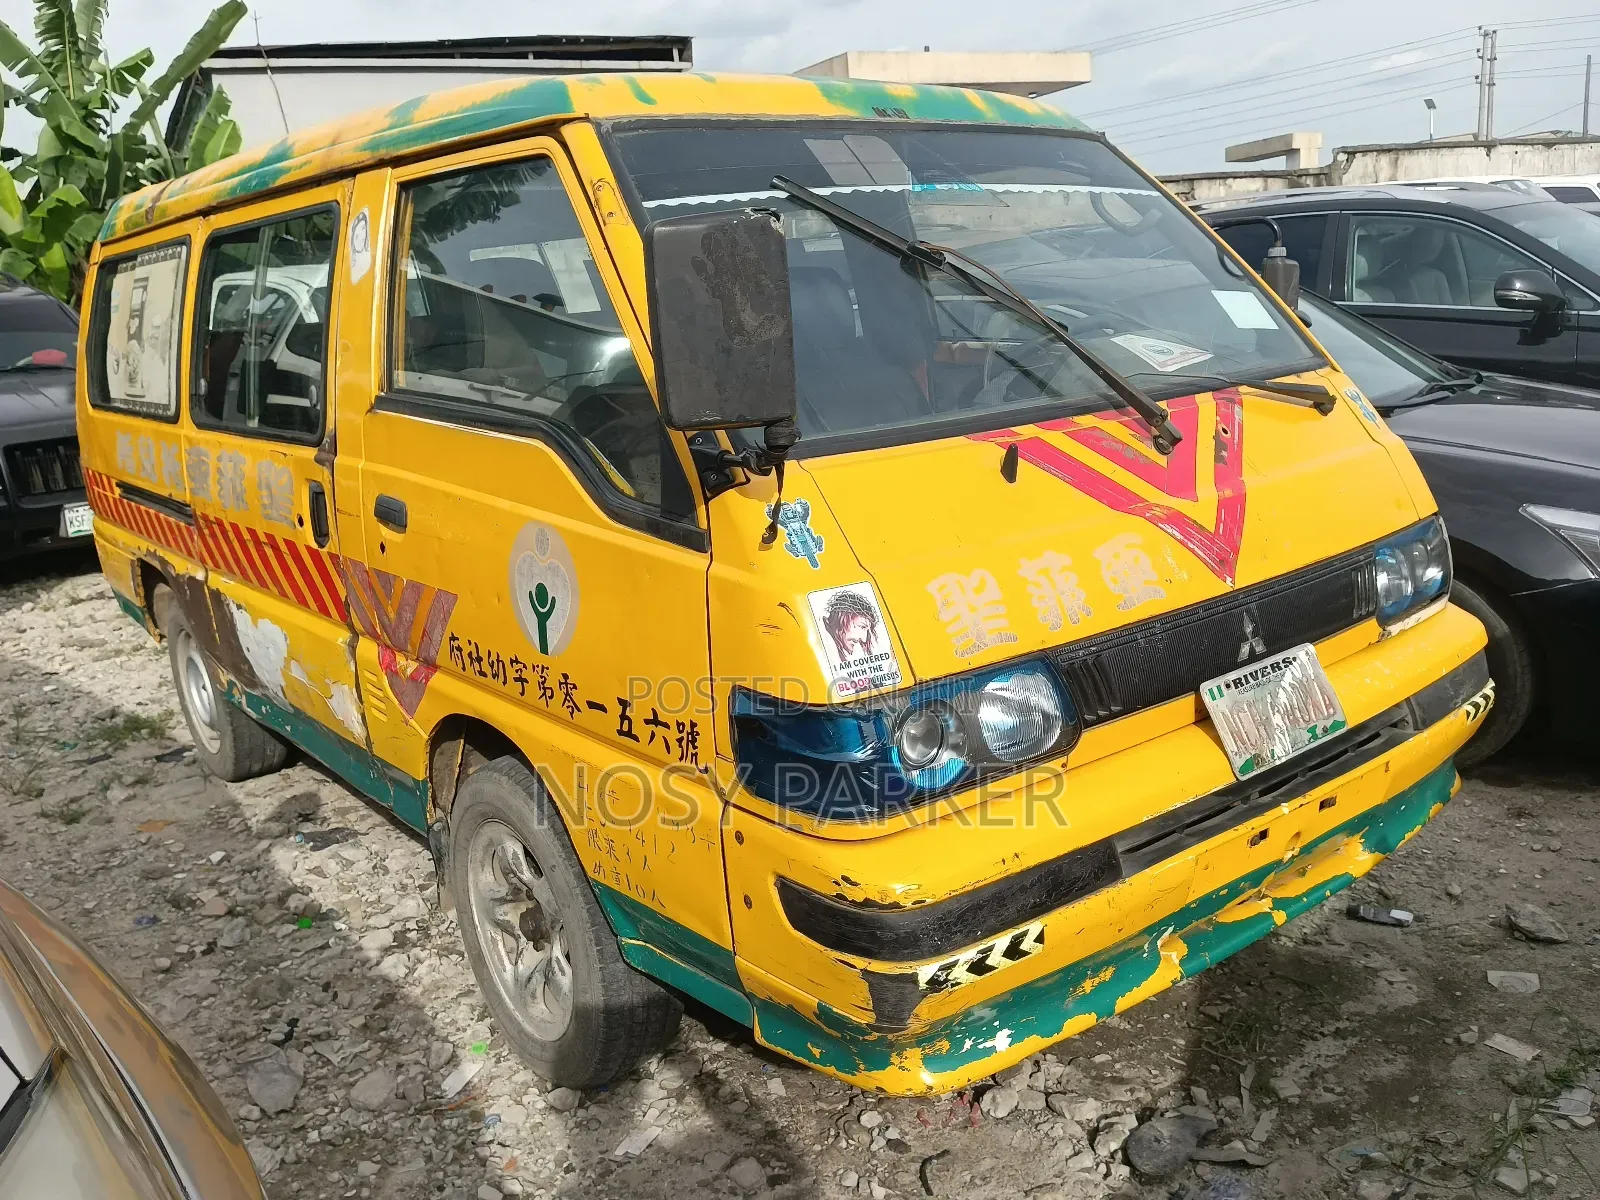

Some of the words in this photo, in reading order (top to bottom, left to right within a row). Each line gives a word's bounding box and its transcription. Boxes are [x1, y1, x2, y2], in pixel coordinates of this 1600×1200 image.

[840, 660, 852, 671] AM
[853, 652, 890, 667] COVERED
[847, 667, 868, 679] WITH
[868, 664, 884, 675] THE
[1231, 656, 1293, 690] RIVERS
[838, 676, 871, 693] BLOOD
[449, 632, 709, 775] 府社幼字第零一五六號
